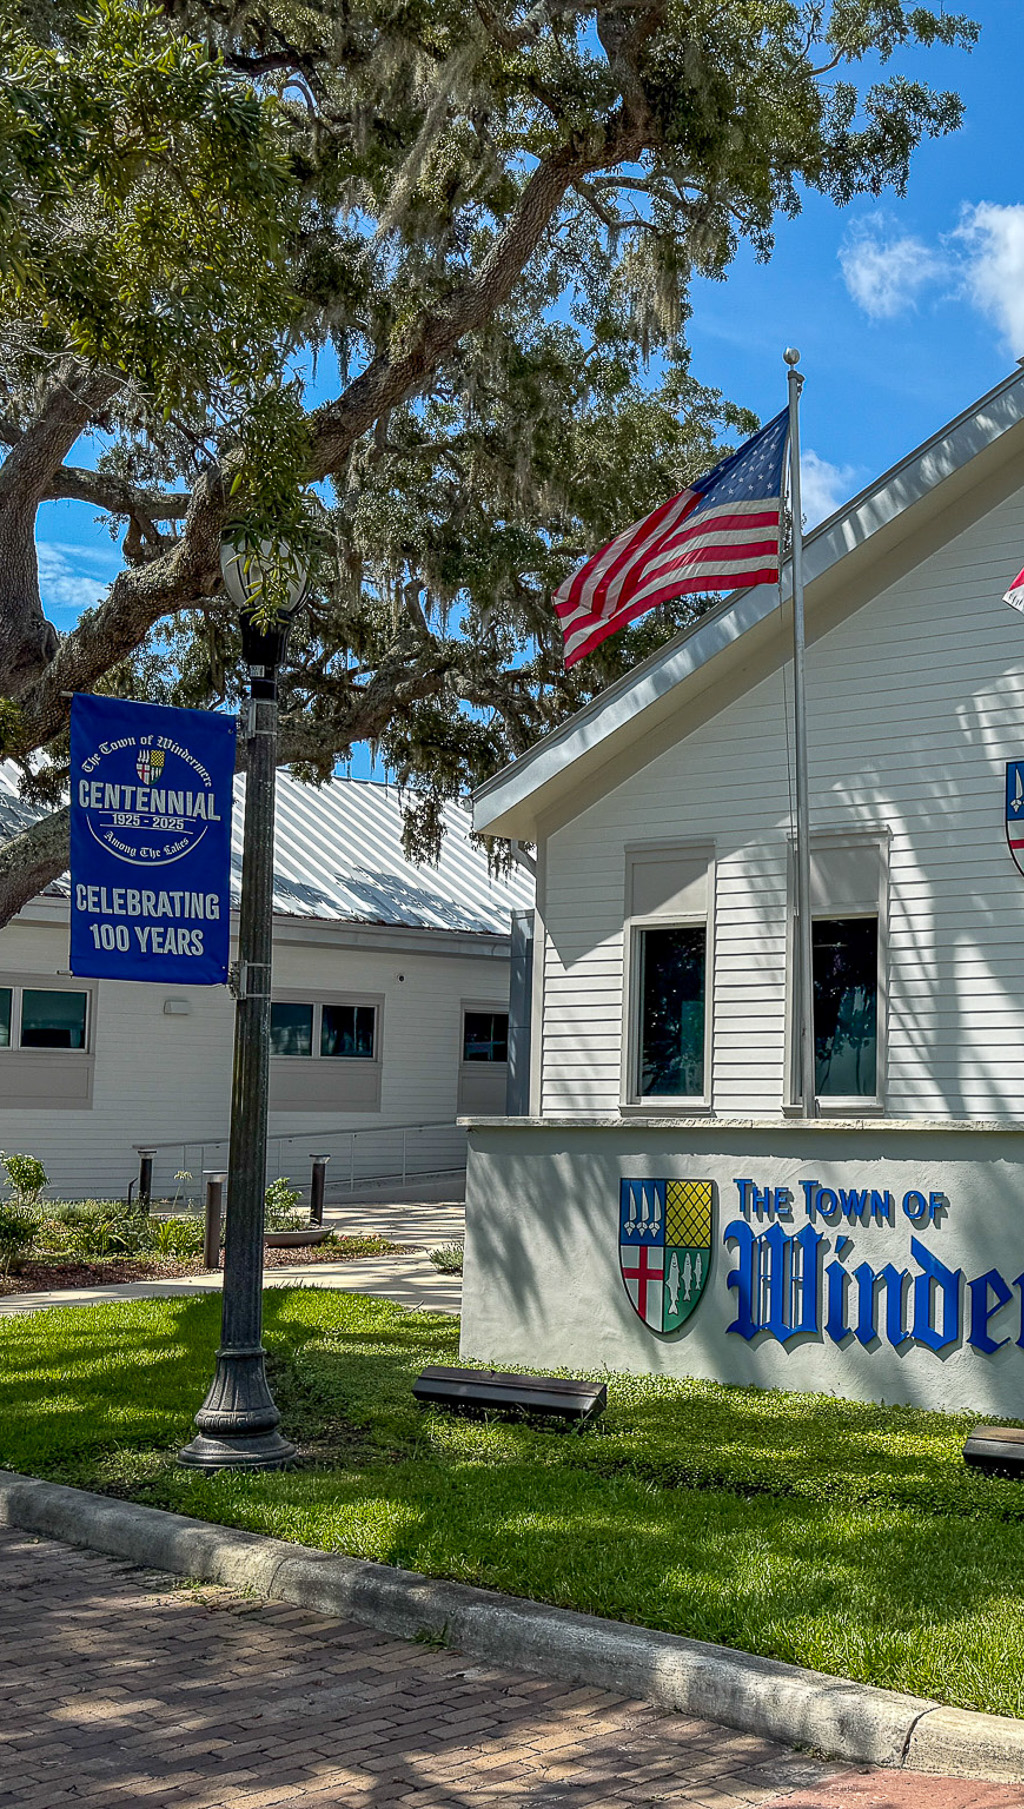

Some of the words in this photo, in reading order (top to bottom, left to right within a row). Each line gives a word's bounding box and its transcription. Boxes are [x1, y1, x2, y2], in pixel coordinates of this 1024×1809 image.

[81, 753, 101, 773] The
[99, 737, 136, 755] Town
[140, 734, 154, 745] of
[156, 735, 212, 788] Windermere
[79, 779, 221, 821] CENTENNIAL
[112, 813, 140, 826] 1925
[152, 816, 185, 830] 2025
[103, 830, 137, 857] Among
[140, 846, 161, 859] The
[163, 837, 190, 856] Lakes
[75, 883, 221, 921] CELEBRATING
[89, 923, 131, 951] 100
[134, 926, 205, 957] YEARS
[733, 1178, 789, 1214] THE
[798, 1180, 889, 1219] TOWN
[902, 1190, 944, 1220] OF
